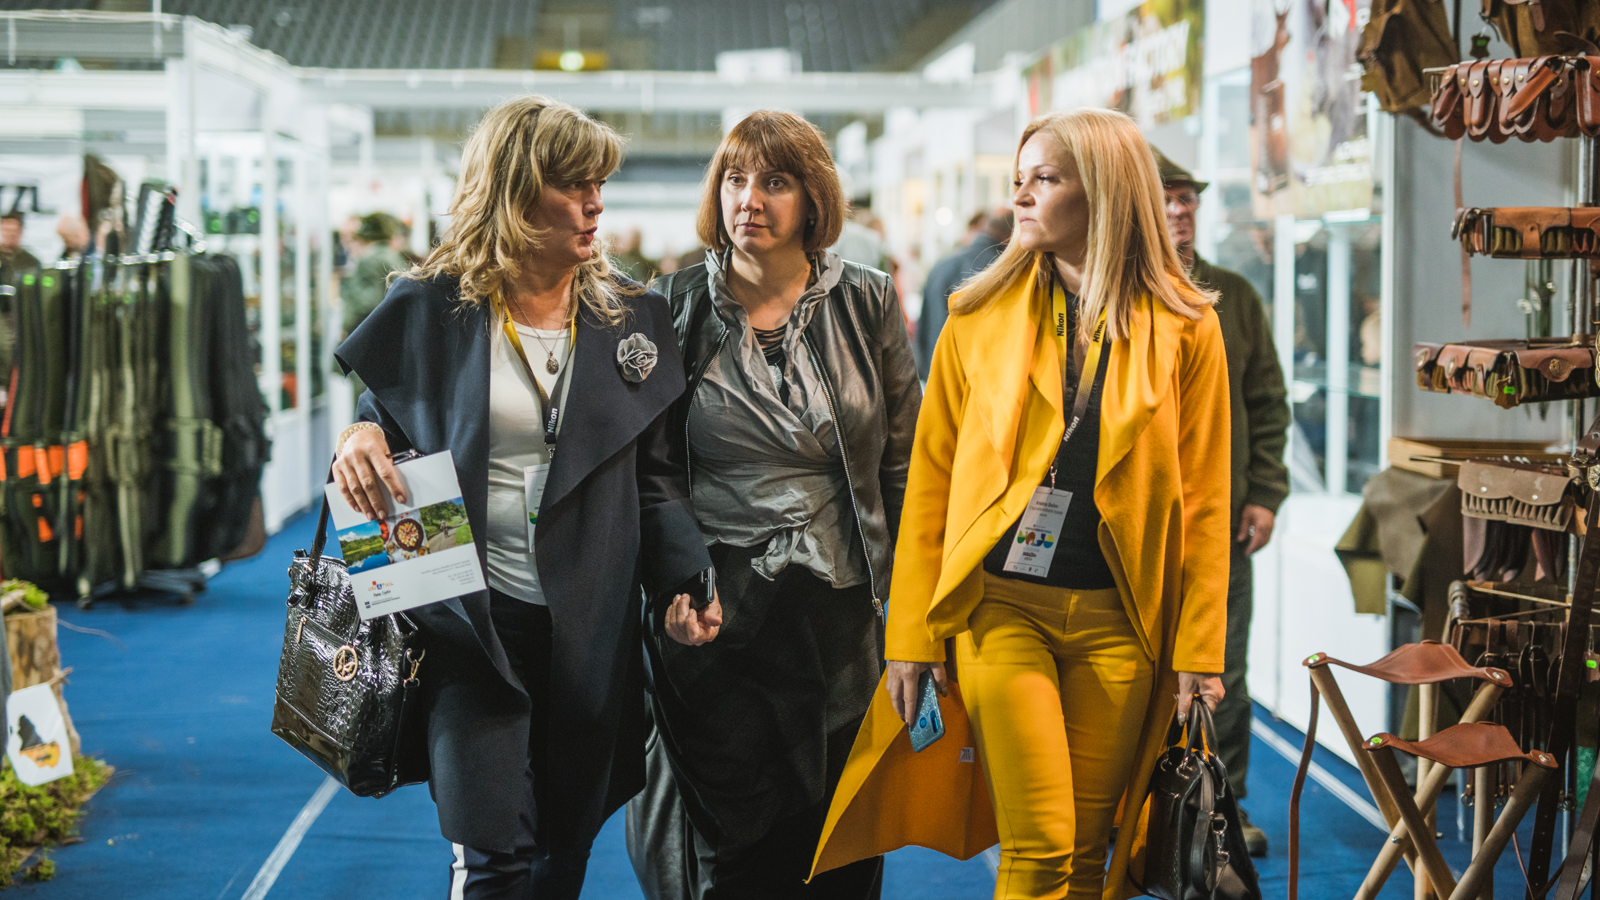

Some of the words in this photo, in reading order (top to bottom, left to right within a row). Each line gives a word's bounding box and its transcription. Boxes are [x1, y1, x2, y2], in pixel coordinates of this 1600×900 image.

[1057, 312, 1065, 337] Nikon
[1093, 320, 1105, 343] Nikon
[547, 407, 558, 433] Nikon
[1063, 415, 1080, 442] Nikon
